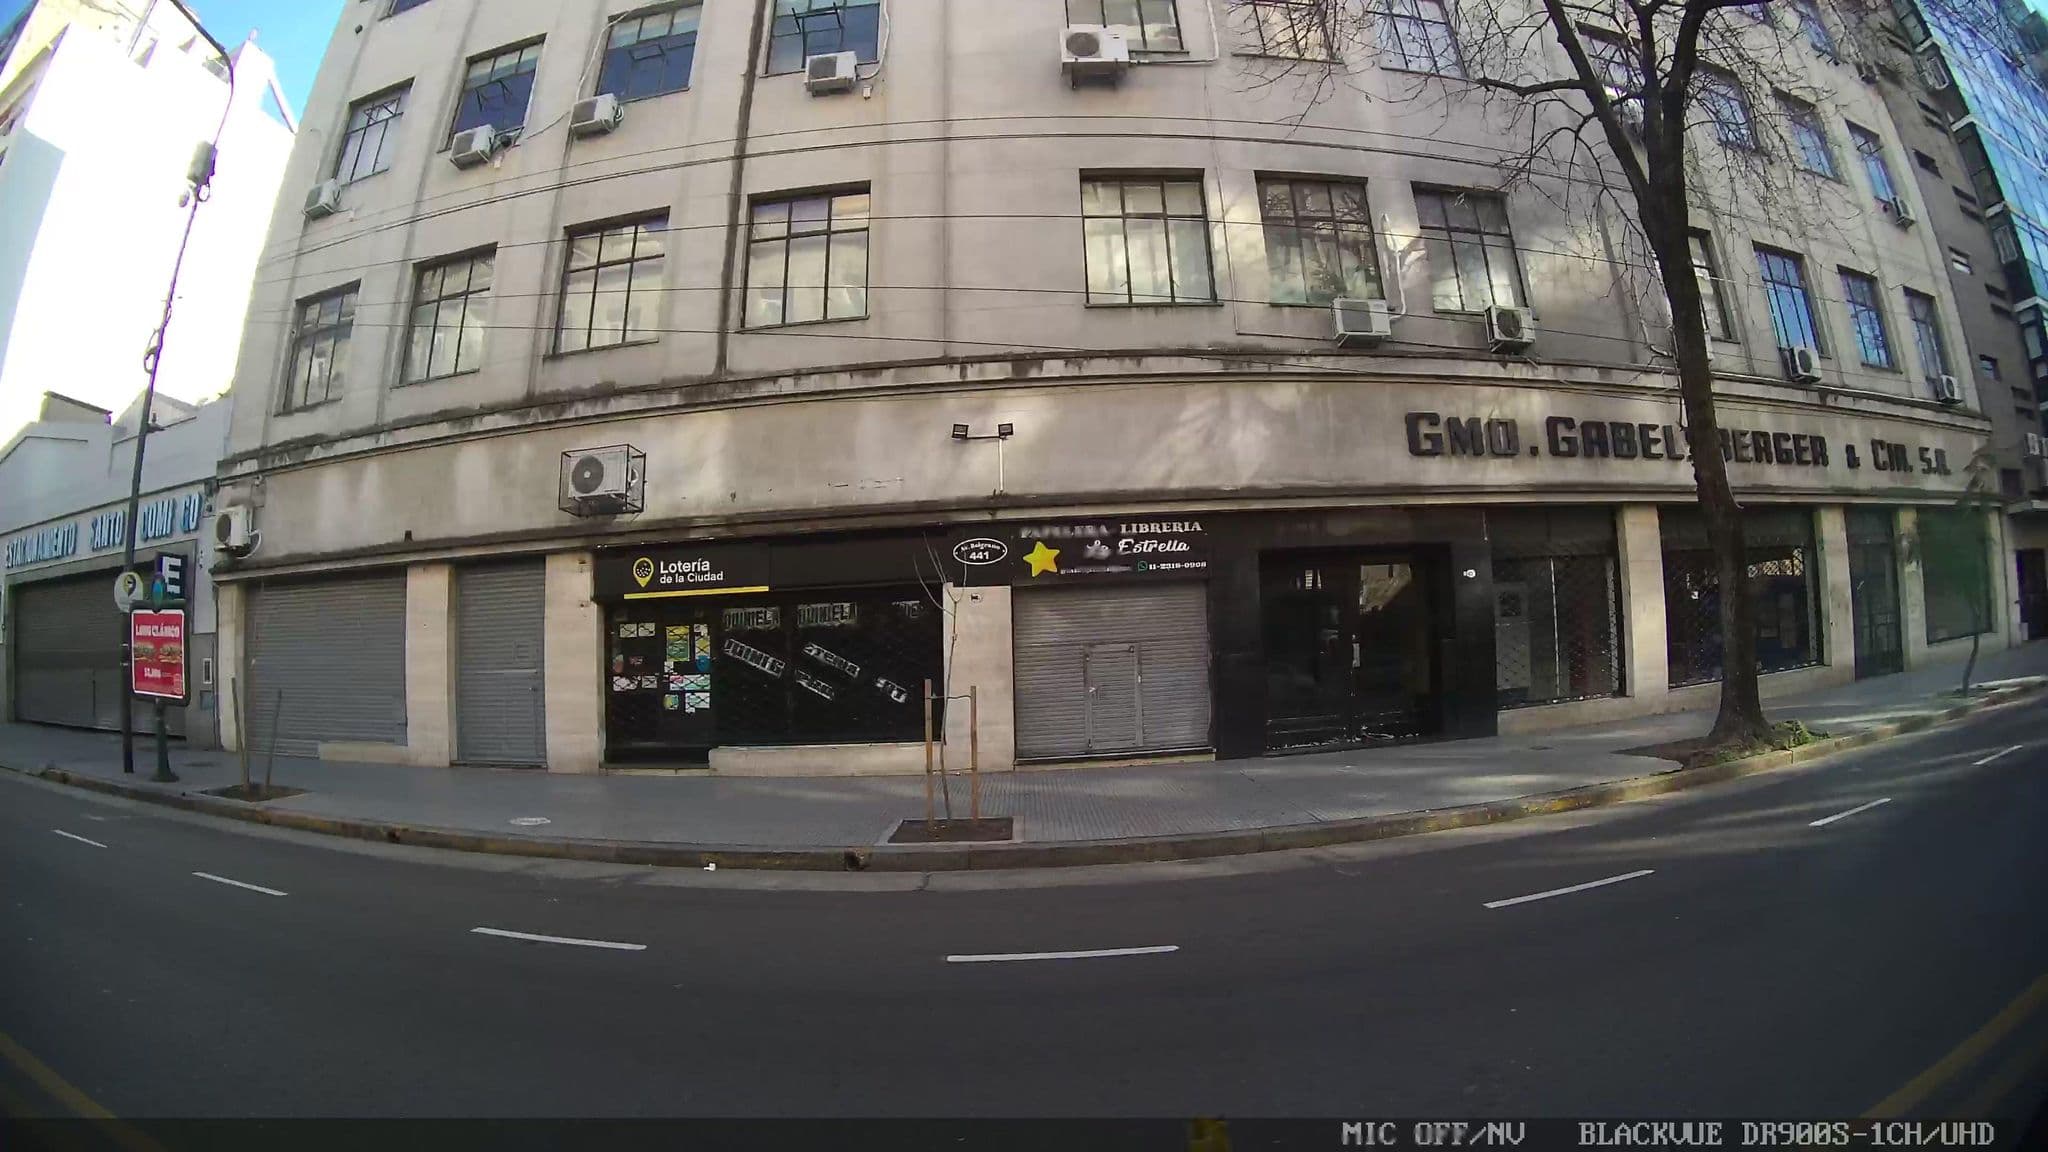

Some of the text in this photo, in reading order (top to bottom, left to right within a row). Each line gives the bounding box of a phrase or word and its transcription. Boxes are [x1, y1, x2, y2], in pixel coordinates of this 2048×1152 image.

[1546, 416, 1829, 468] GABELBERGER
[92, 510, 126, 552] SANTO
[1120, 521, 1203, 534] LIBRERIA
[970, 541, 1001, 550] Belgrano
[1117, 538, 1190, 555] Estrella
[969, 551, 990, 560] 441
[660, 558, 710, 574] Lotería
[162, 556, 182, 594] E
[660, 571, 723, 584] de la Ciudad
